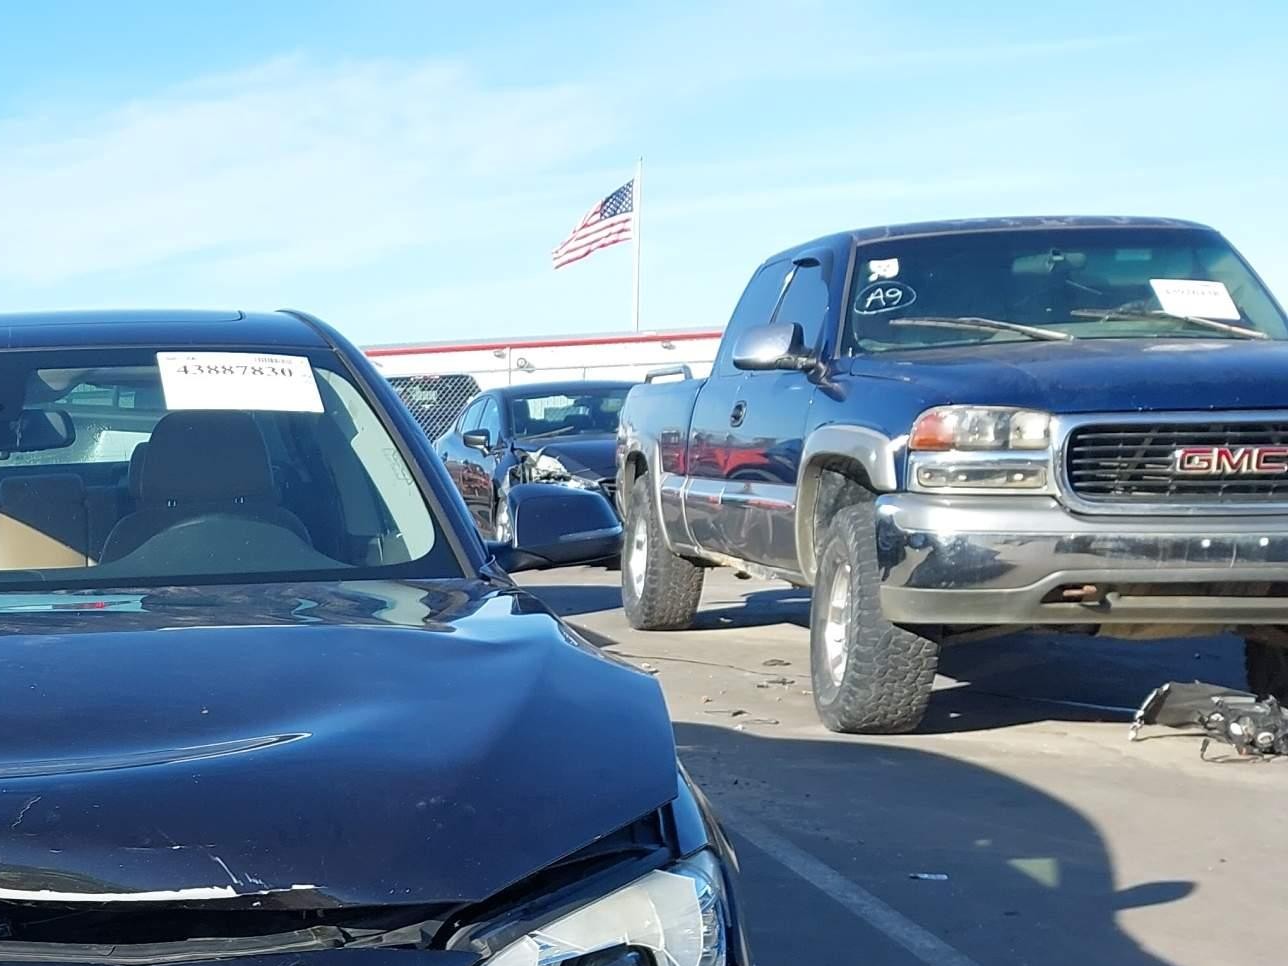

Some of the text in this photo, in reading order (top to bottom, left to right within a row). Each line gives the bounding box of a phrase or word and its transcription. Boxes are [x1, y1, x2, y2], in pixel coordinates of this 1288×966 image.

[865, 287, 903, 308] A9
[176, 364, 294, 377] 43887830
[1174, 447, 1288, 474] GMC
